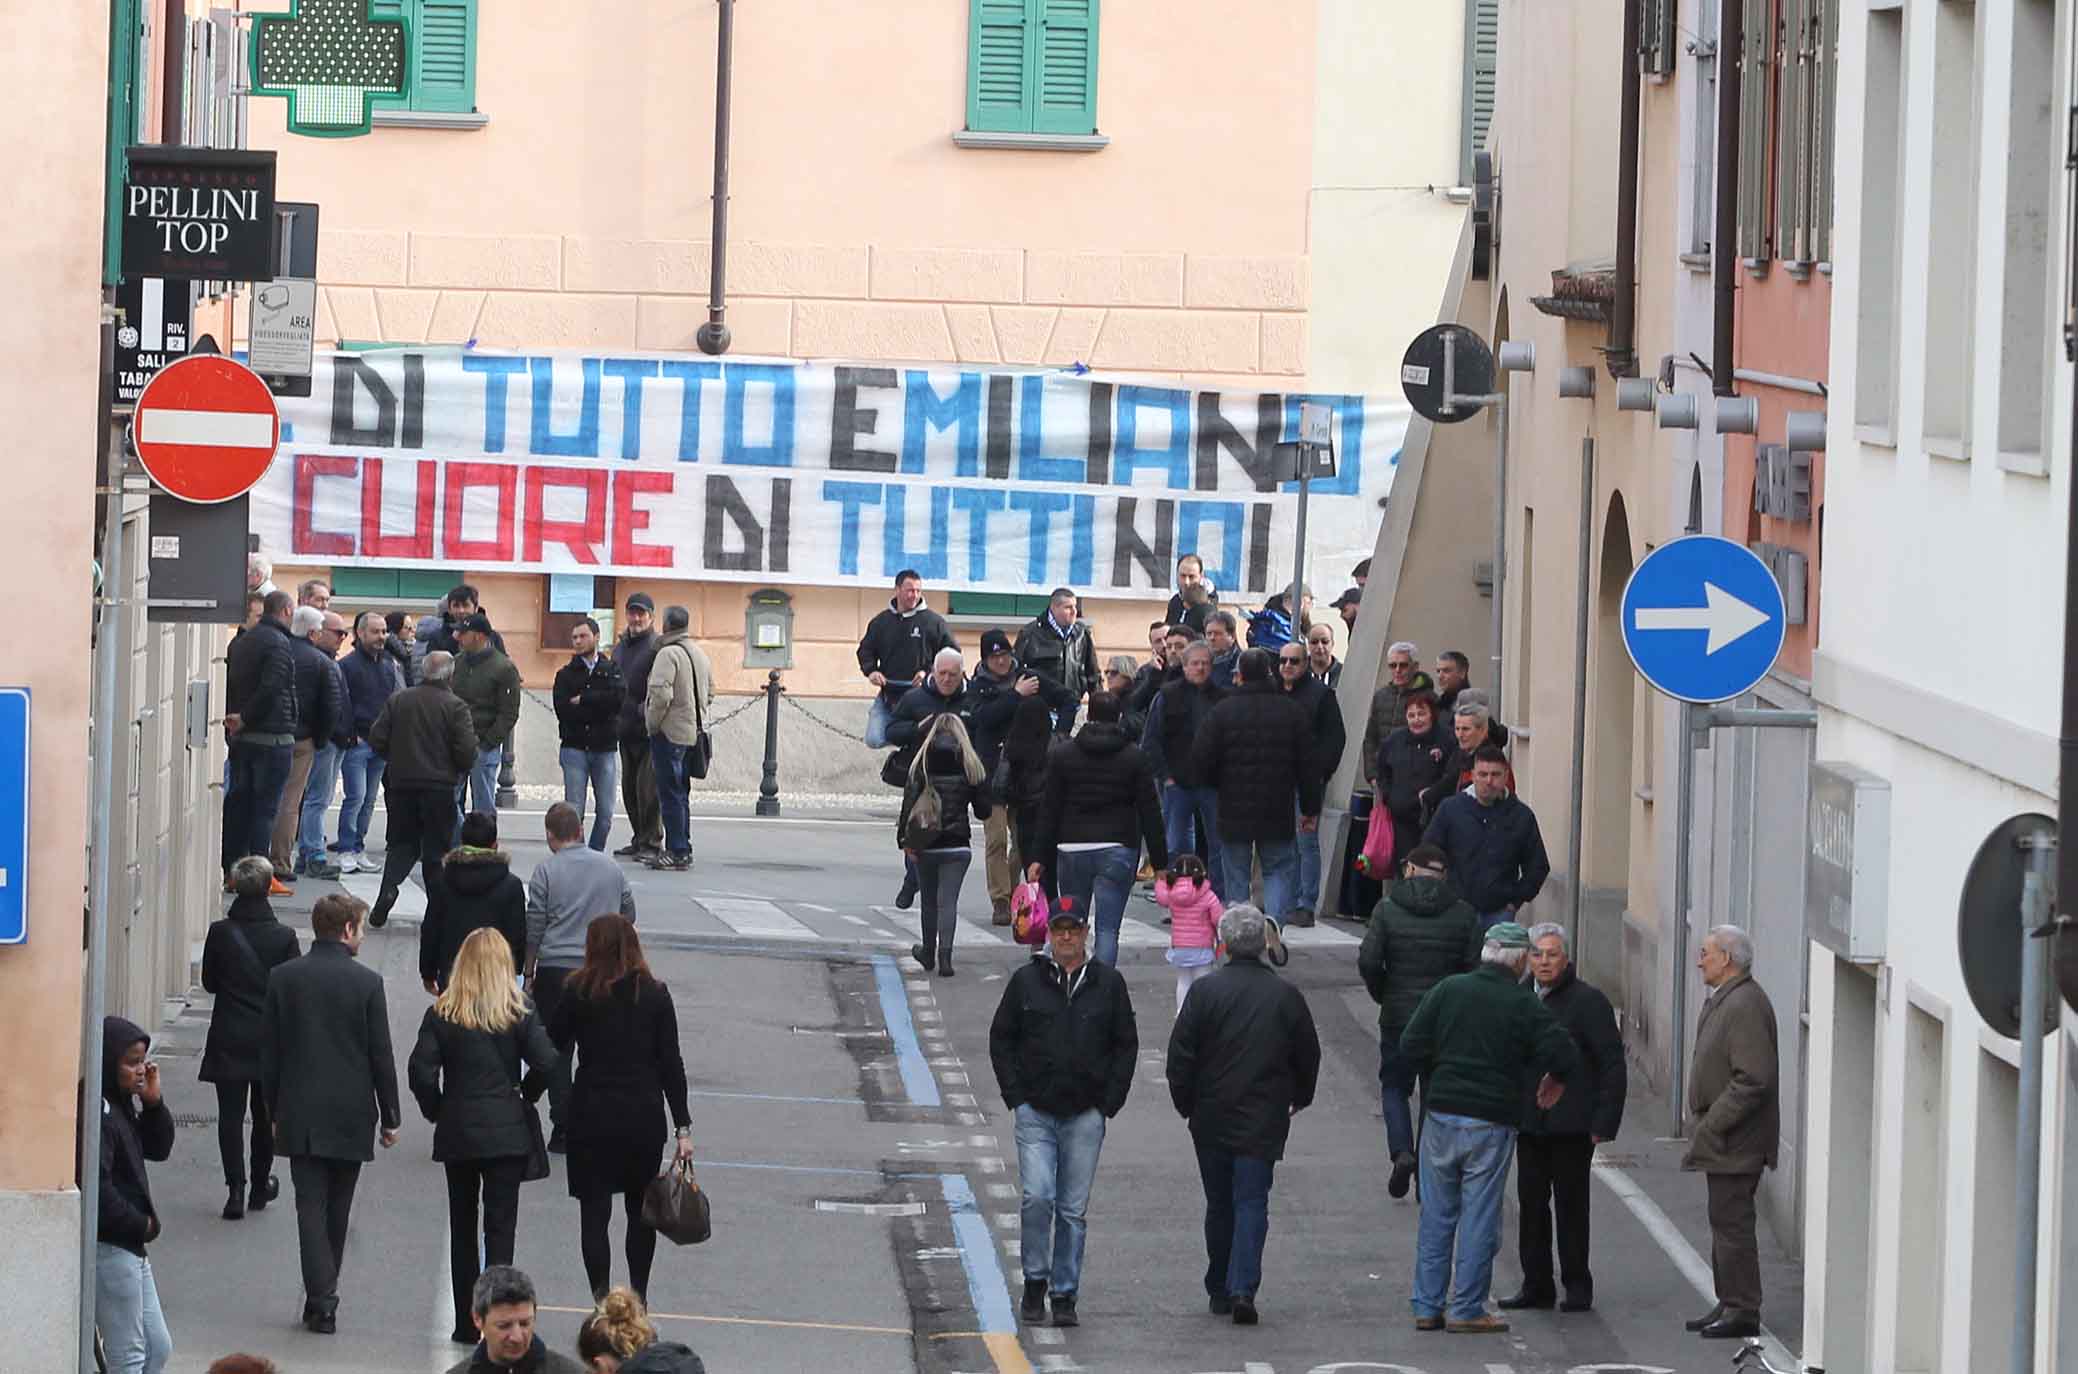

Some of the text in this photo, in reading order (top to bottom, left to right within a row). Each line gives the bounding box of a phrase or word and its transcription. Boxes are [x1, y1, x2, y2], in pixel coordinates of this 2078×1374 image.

[128, 185, 259, 221] PELLINI
[156, 220, 229, 254] TOP
[167, 322, 185, 335] RIV.
[289, 315, 311, 329] AREA
[331, 353, 1365, 496] DI TUTTO EMILIANO
[292, 454, 1272, 593] CUORE DI TUTTI NOI
